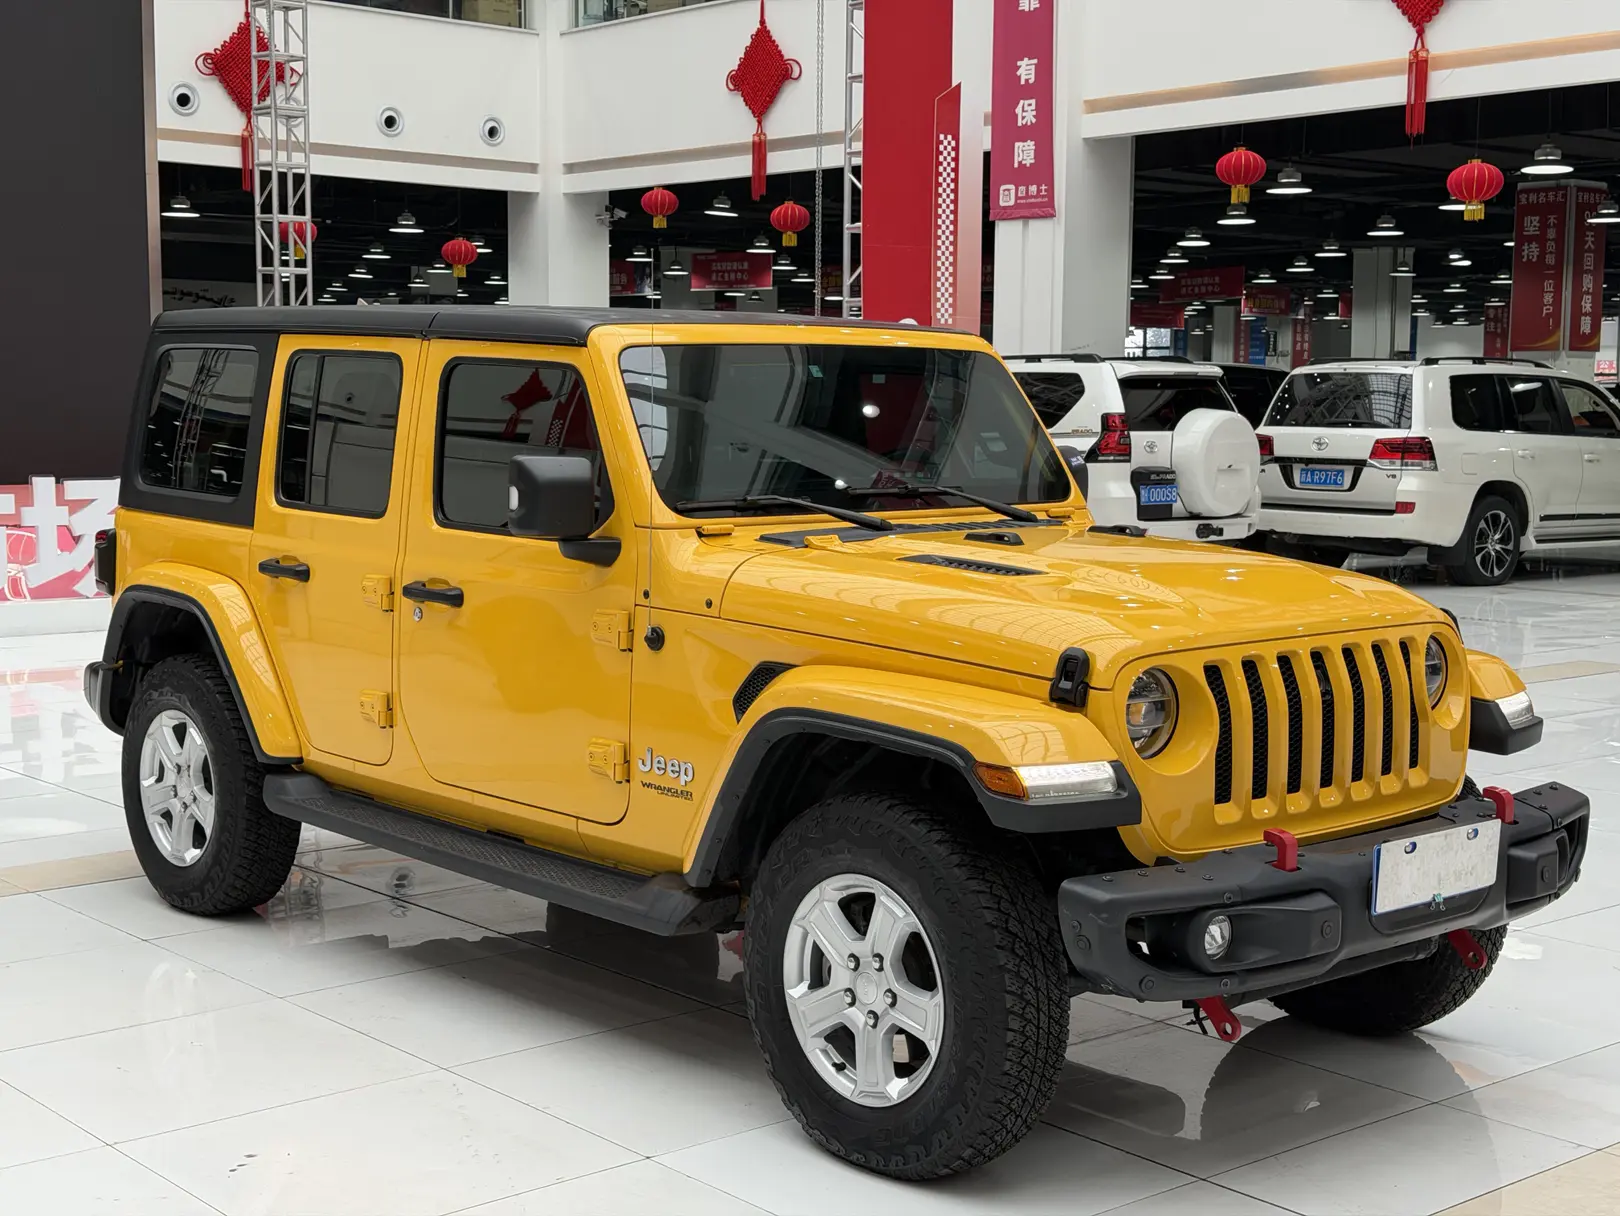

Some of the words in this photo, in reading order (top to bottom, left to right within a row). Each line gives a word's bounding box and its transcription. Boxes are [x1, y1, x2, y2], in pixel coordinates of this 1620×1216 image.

[1013, 57, 1039, 169] 有保障
[1521, 215, 1541, 263] 坚持
[0, 476, 121, 598] 场
[638, 746, 695, 787] Jeep
[640, 780, 693, 799] WRANGLER
